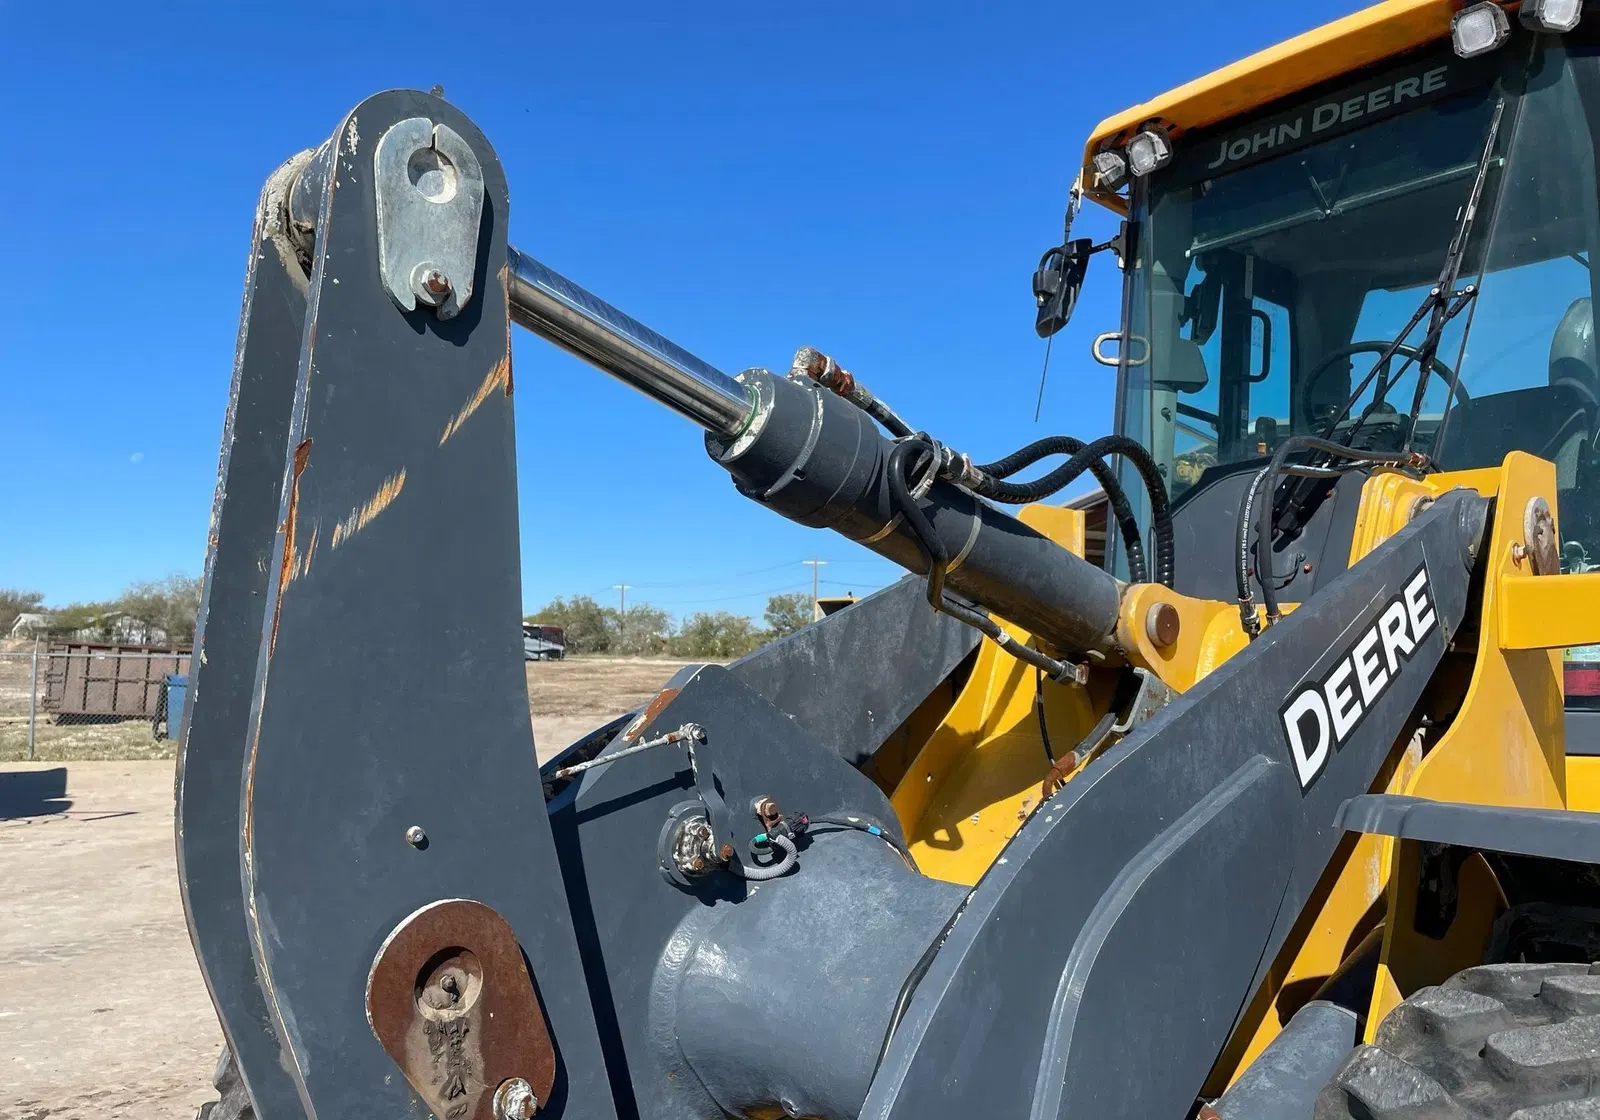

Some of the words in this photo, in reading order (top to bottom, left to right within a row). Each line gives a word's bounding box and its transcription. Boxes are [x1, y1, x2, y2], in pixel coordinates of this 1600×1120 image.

[1208, 117, 1303, 170] JOHN
[1311, 65, 1448, 133] DEERE
[1283, 568, 1436, 788] DEERE
